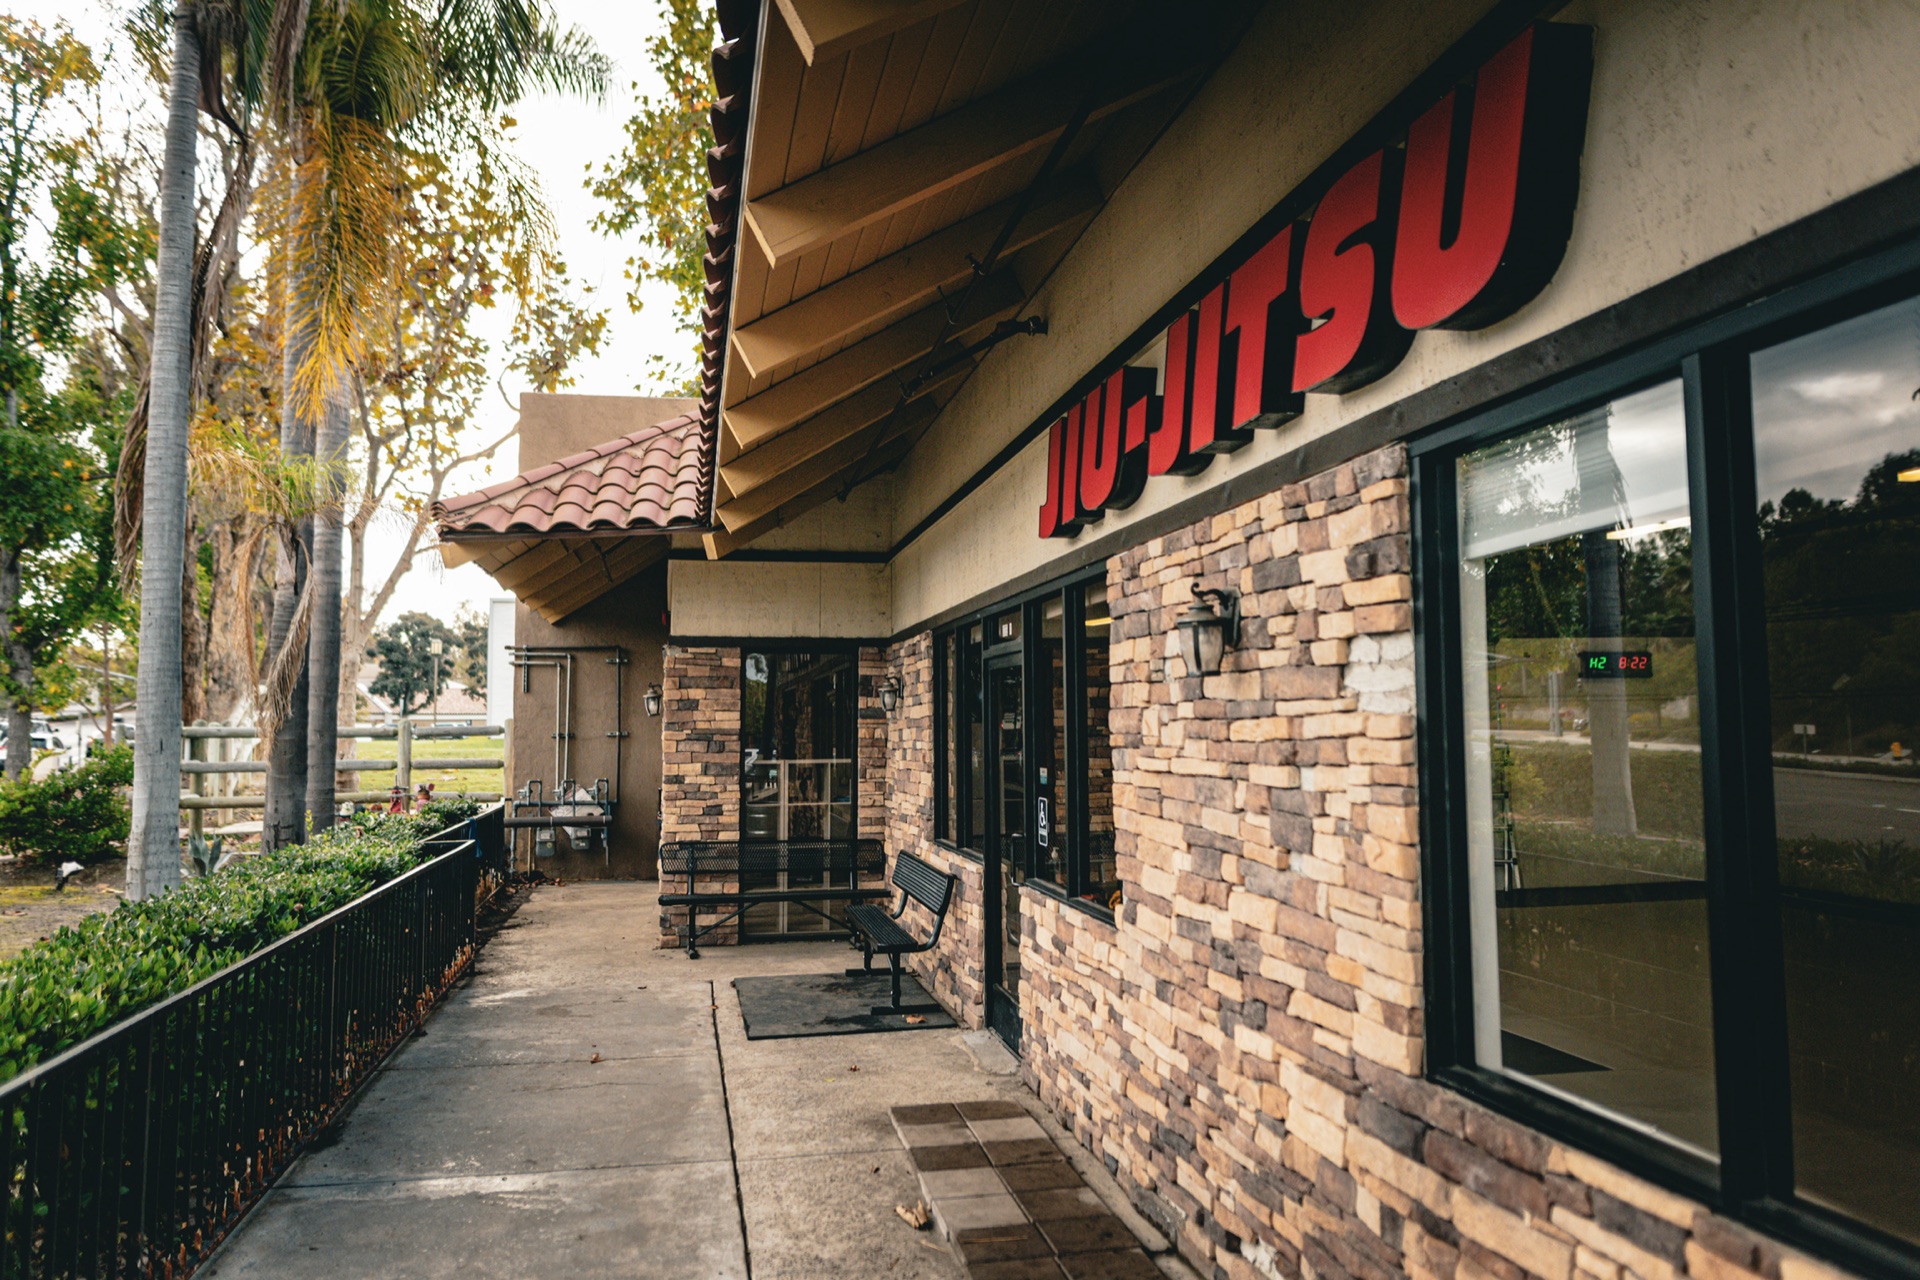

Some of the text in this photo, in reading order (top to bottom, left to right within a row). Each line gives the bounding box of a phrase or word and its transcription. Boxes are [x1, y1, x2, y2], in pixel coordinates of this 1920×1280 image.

[1039, 23, 1550, 539] JIU-JITSU
[1589, 656, 1648, 669] H2 8:22
